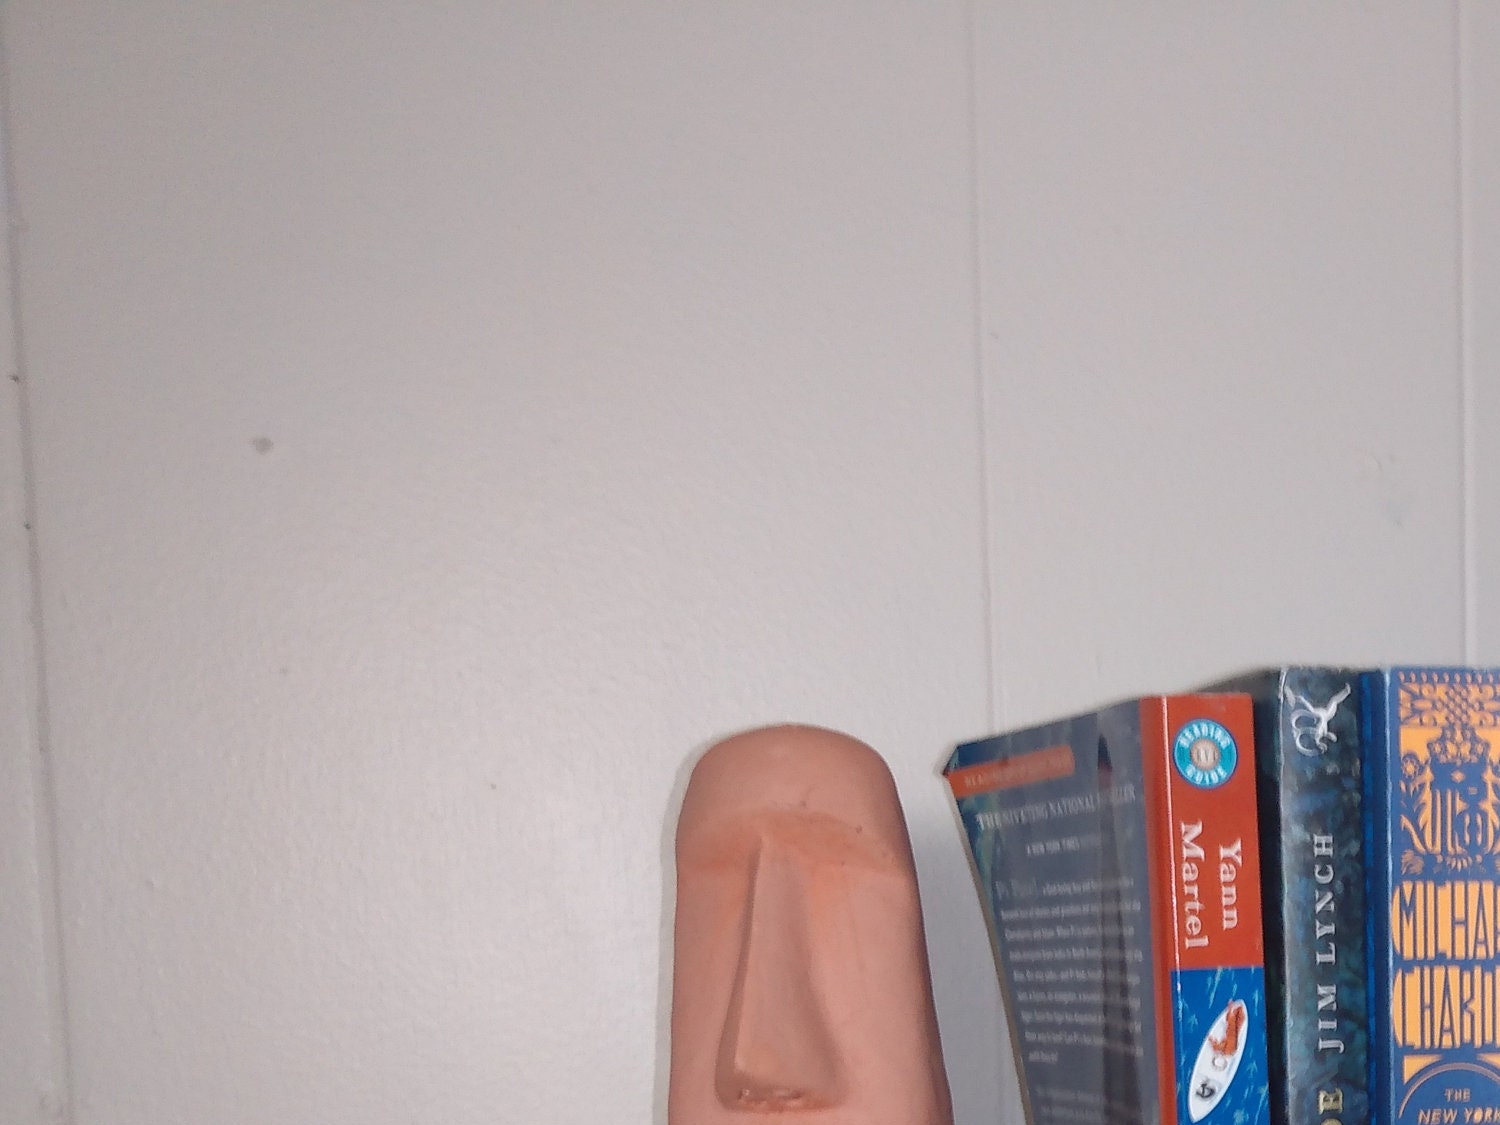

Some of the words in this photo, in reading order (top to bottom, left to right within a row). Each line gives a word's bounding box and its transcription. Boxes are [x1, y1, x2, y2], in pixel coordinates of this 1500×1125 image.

[1186, 764, 1227, 785] GUIDE
[1178, 820, 1210, 950] Martel
[1217, 838, 1243, 931] Yann
[1313, 832, 1337, 966] LYNCH
[1317, 981, 1345, 1054] JIM
[1418, 1108, 1458, 1125] NEW
[1444, 1088, 1471, 1103] THE
